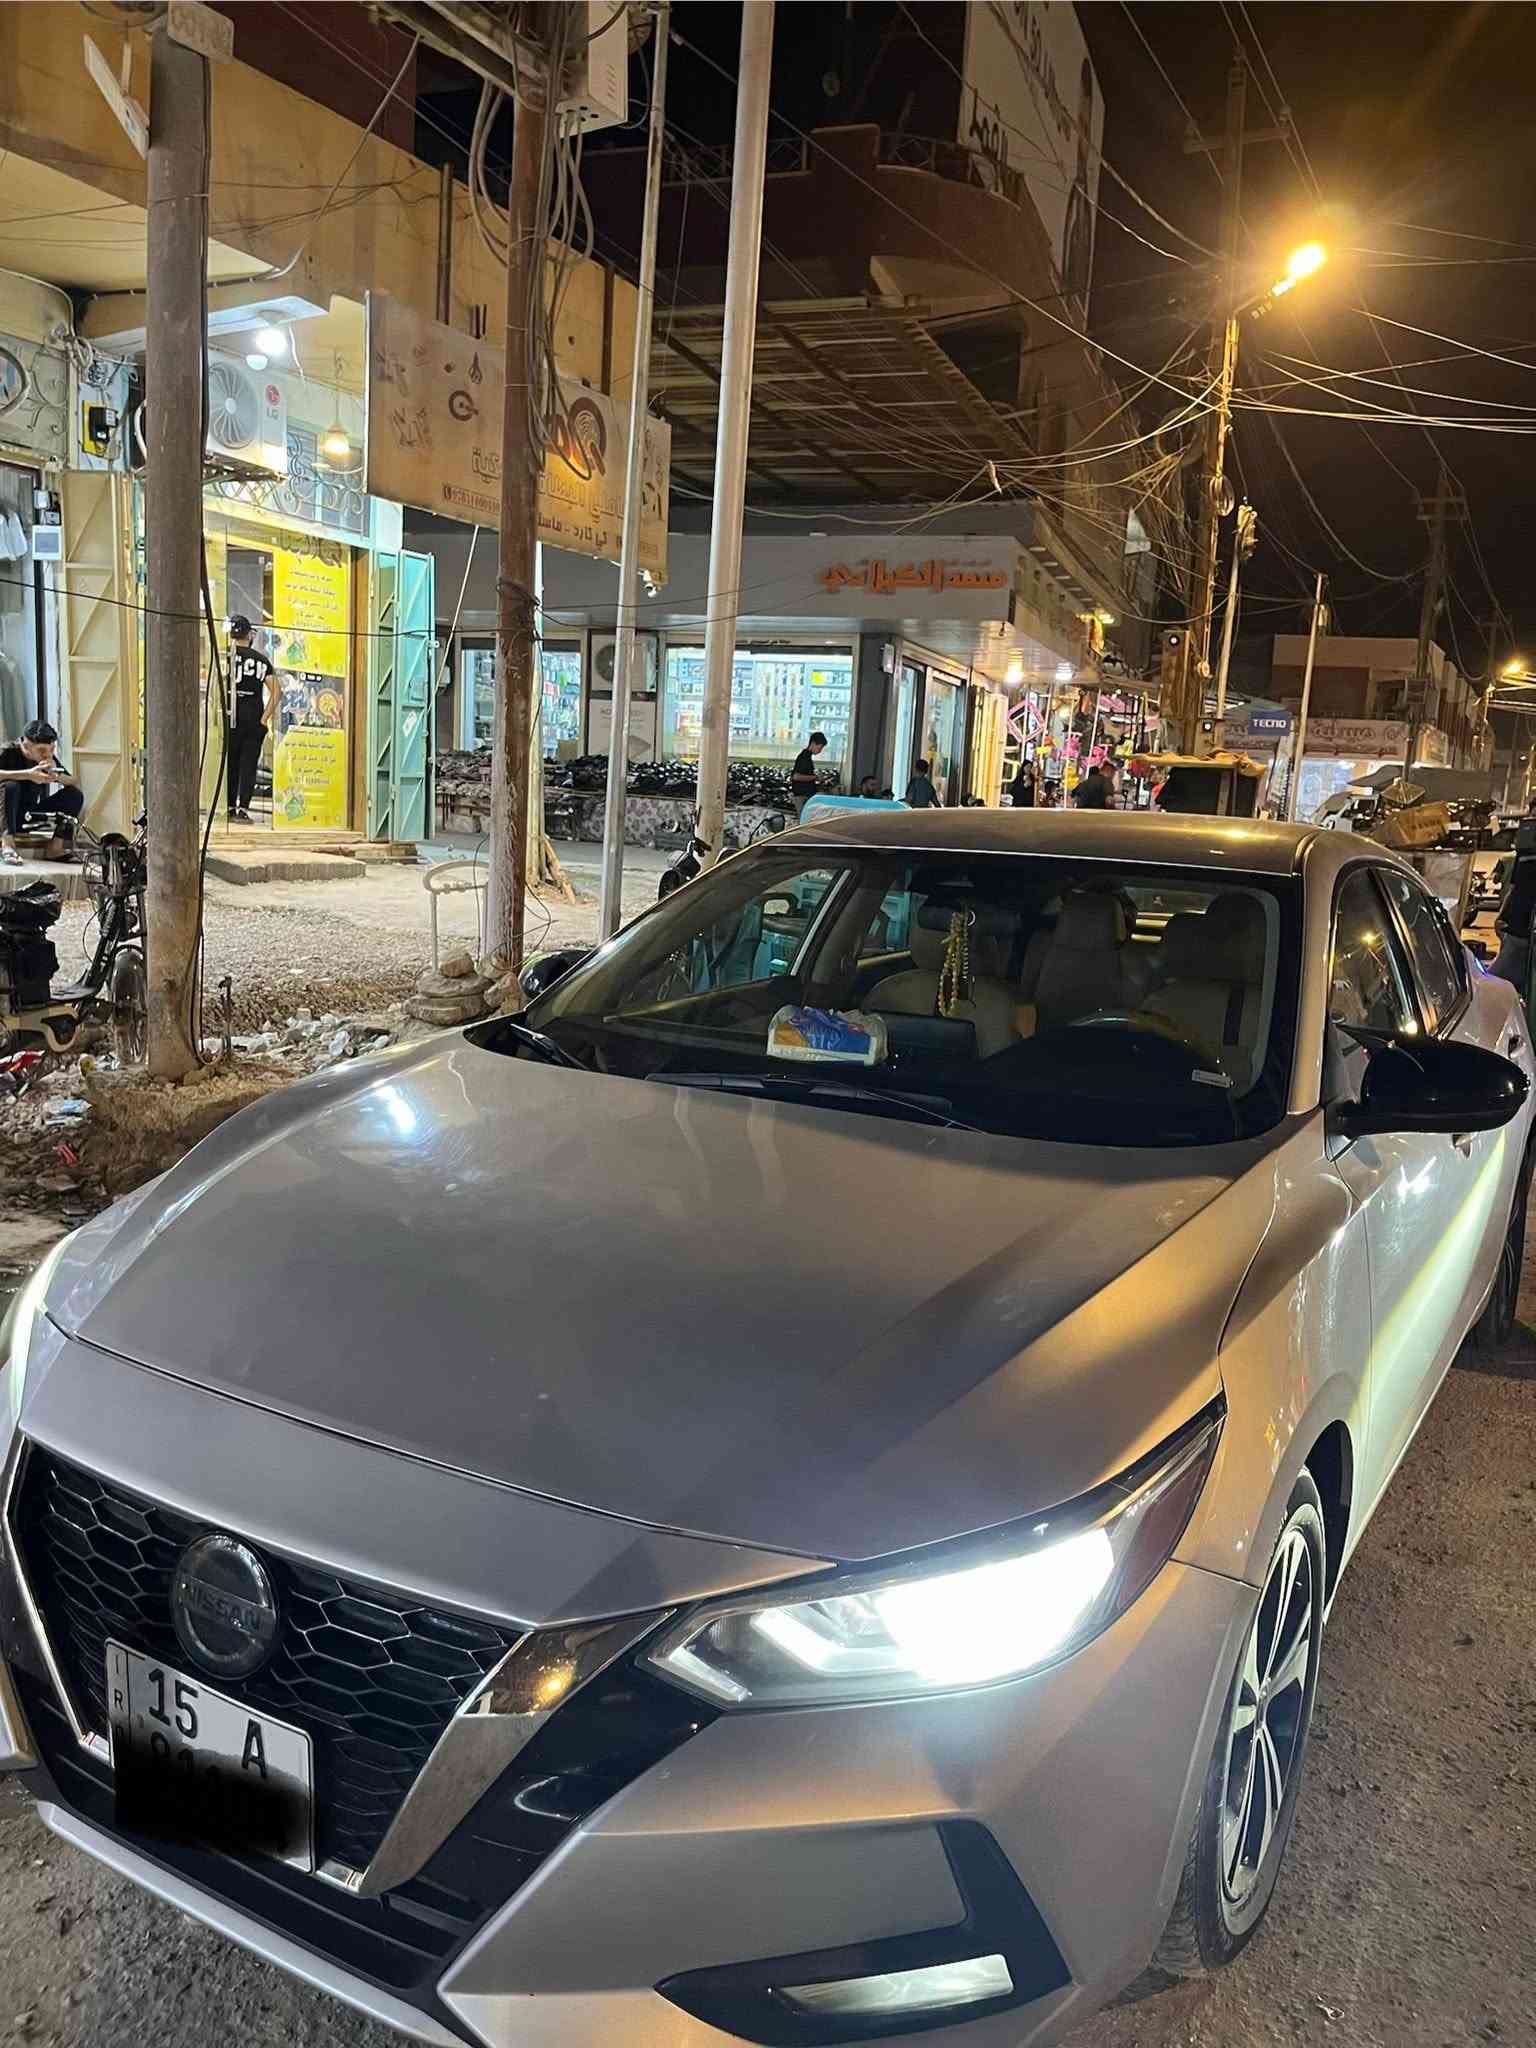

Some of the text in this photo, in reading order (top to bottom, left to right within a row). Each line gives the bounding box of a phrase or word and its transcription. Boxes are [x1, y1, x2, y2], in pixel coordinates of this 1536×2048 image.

[1252, 718, 1287, 728] TECNO
[180, 1583, 260, 1632] NISSAN
[148, 1668, 199, 1740] 15
[241, 1717, 268, 1779] A
